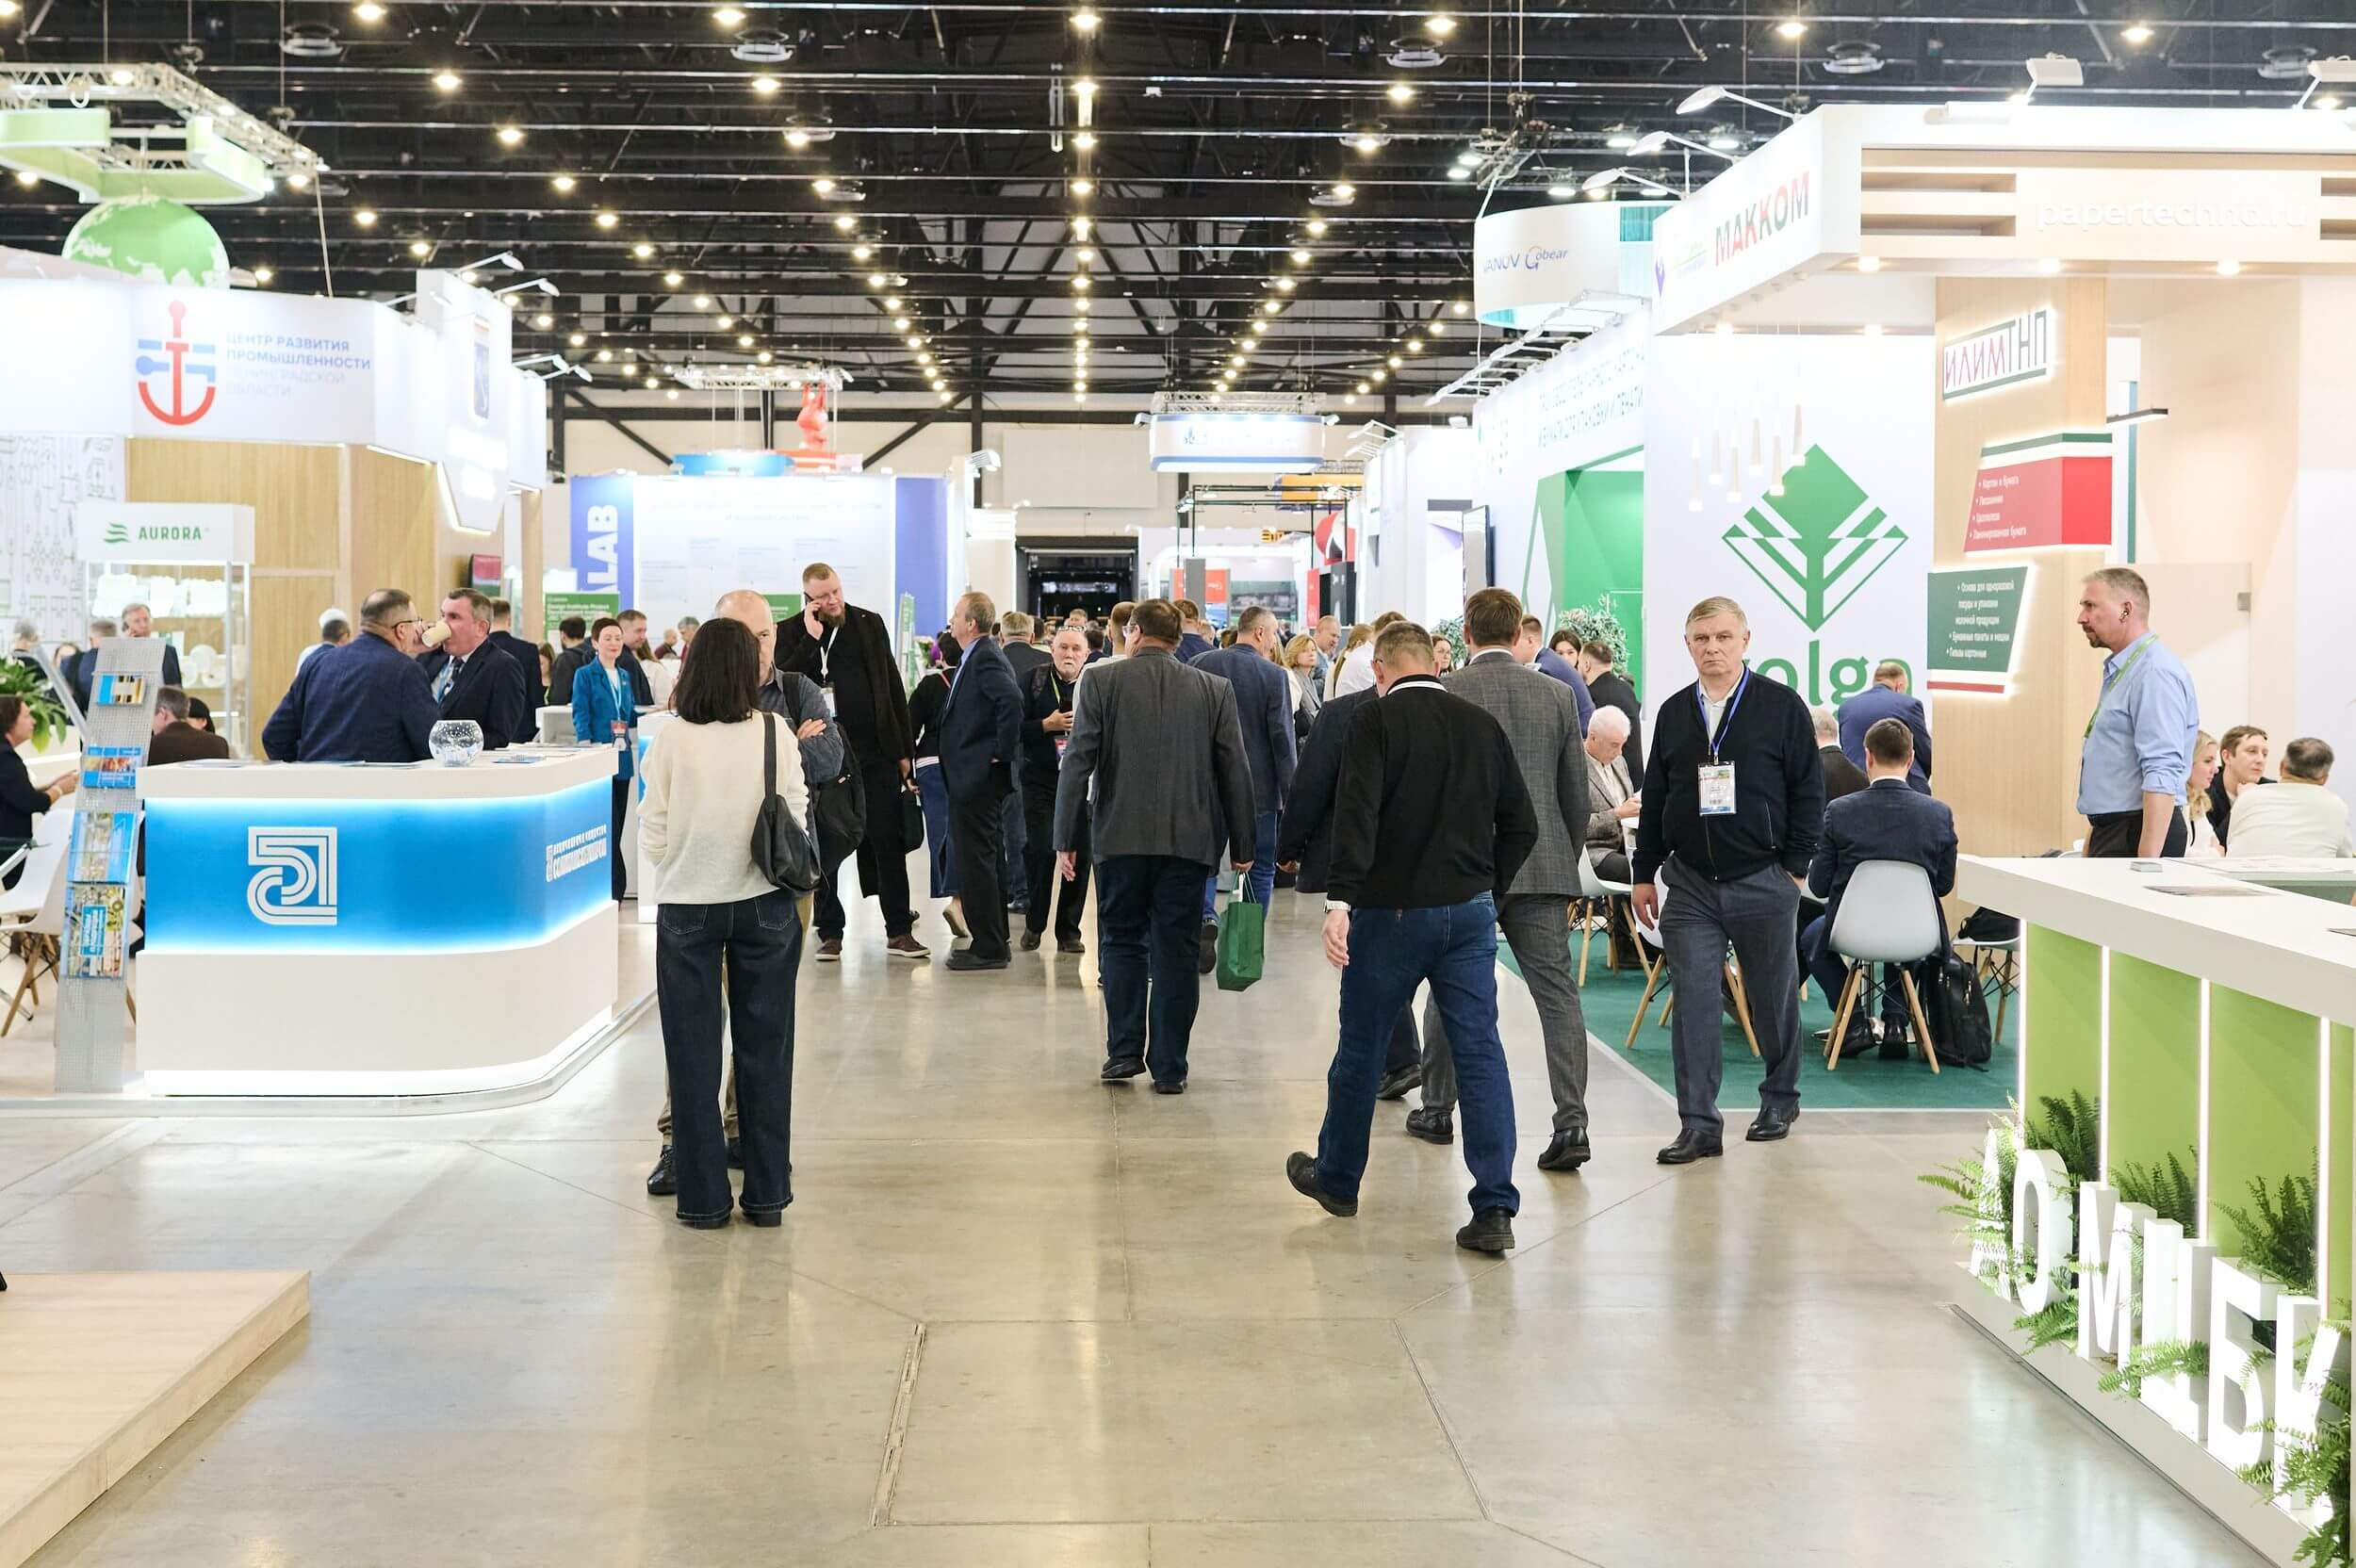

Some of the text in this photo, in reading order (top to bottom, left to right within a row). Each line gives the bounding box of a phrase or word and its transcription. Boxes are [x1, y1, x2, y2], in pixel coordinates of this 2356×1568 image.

[1715, 171, 1809, 267] МАККОМ
[2038, 195, 2308, 233] papertechno.ru
[226, 334, 350, 352] ЦЕНТР РАЗВИТИЯ
[226, 350, 371, 370] ПРОМЫШЛЕННОСТИ
[138, 526, 203, 541] AURORA
[1743, 640, 1912, 723] olga
